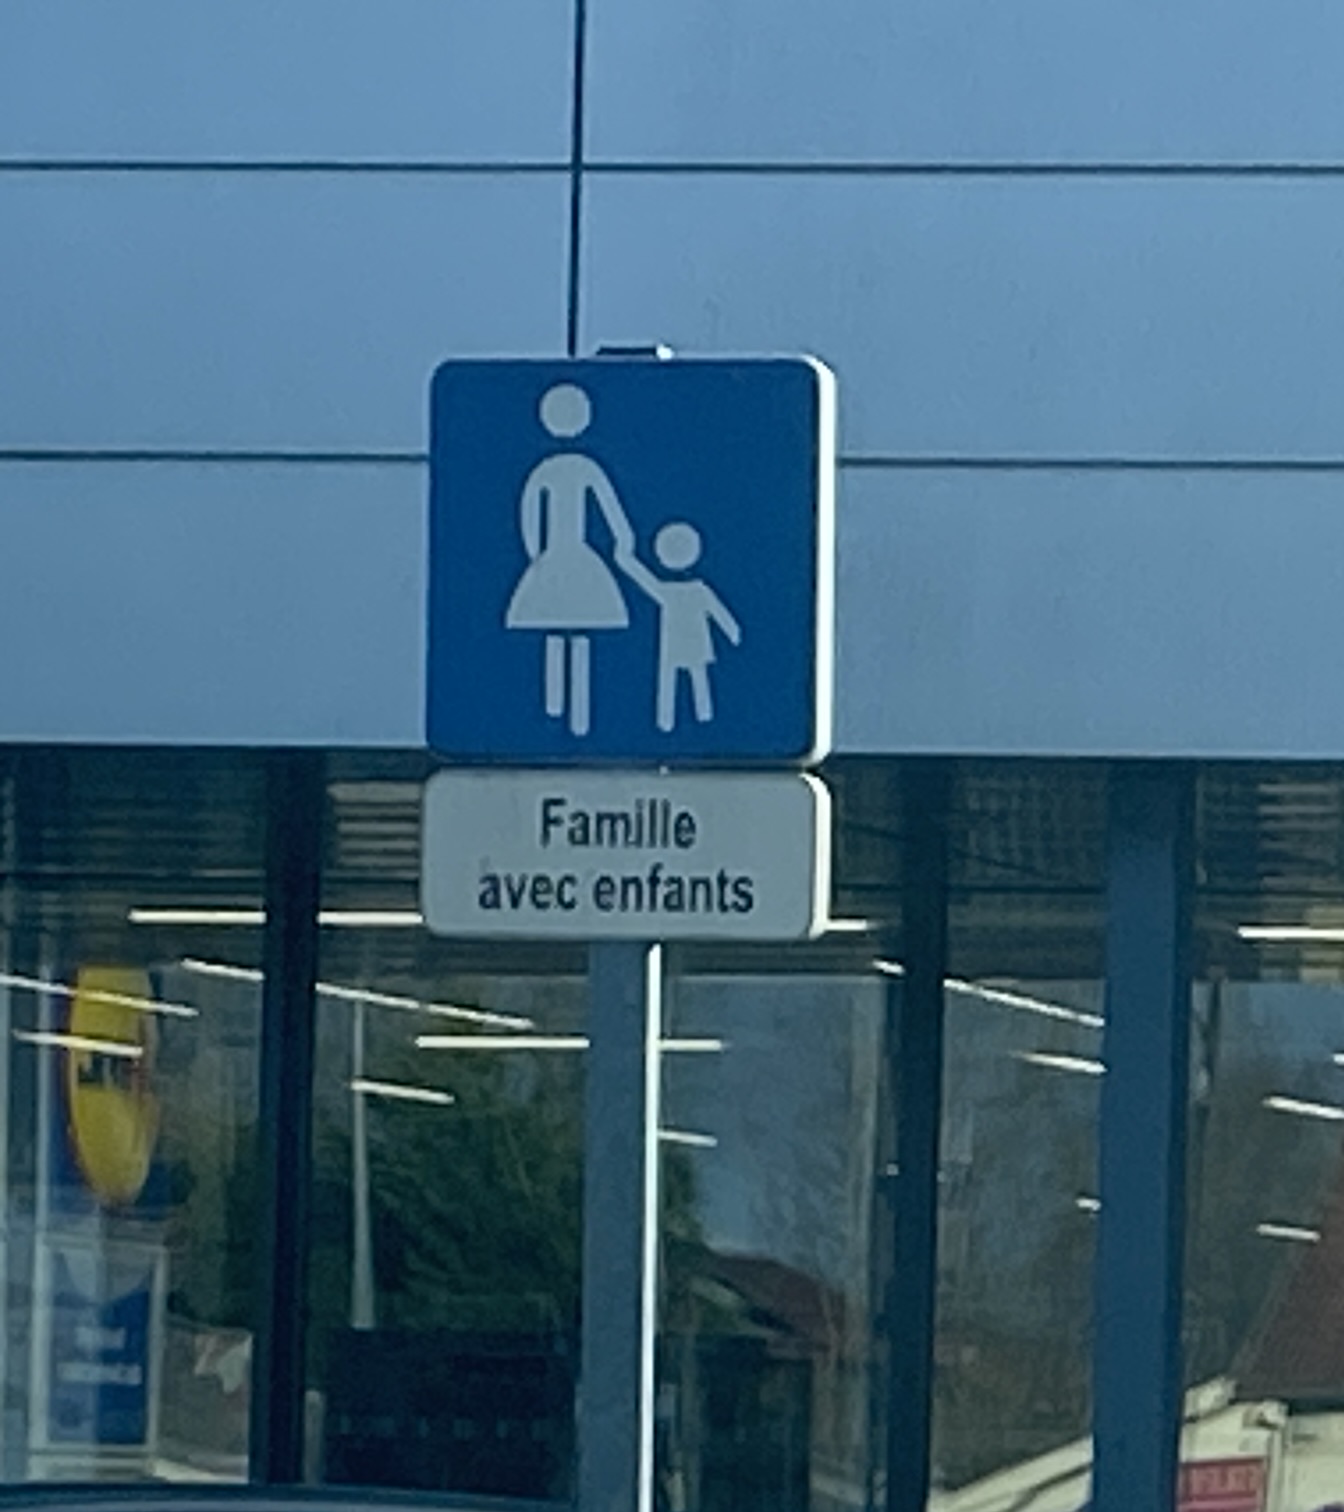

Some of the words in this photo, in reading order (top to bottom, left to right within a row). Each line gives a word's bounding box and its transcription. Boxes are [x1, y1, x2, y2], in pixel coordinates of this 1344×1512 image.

[540, 798, 697, 849] Famille
[478, 871, 578, 910] avec
[594, 863, 755, 912] enfants
